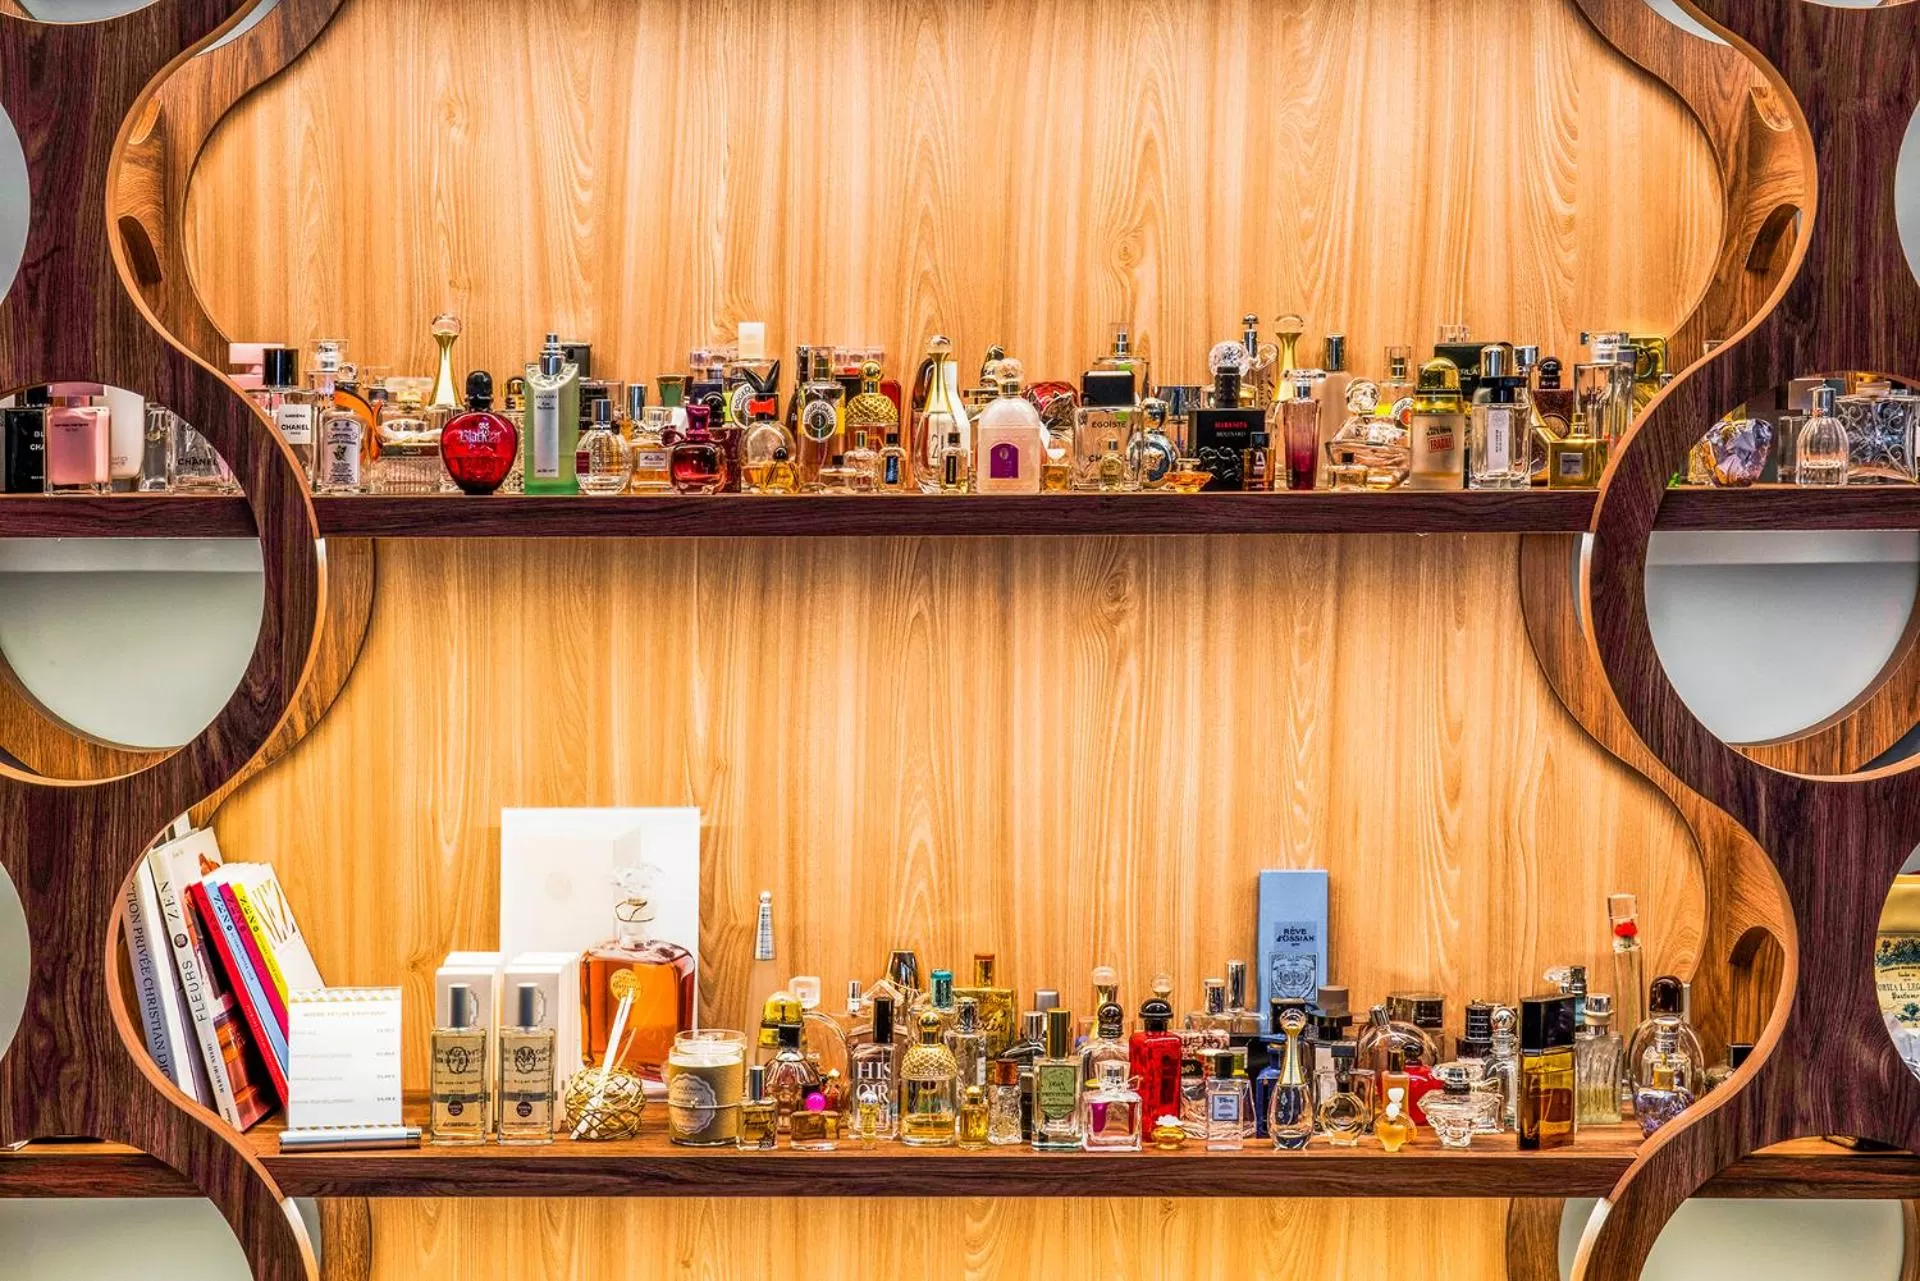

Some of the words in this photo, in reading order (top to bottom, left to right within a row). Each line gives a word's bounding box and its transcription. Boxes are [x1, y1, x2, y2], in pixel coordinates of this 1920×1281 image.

[281, 424, 310, 432] CHANEL
[133, 927, 152, 976] PRIVÉE
[161, 881, 180, 921] ZEN
[182, 960, 207, 1022] FLEURS
[142, 977, 166, 1055] CHRISTIAN
[157, 1054, 173, 1081] DIO
